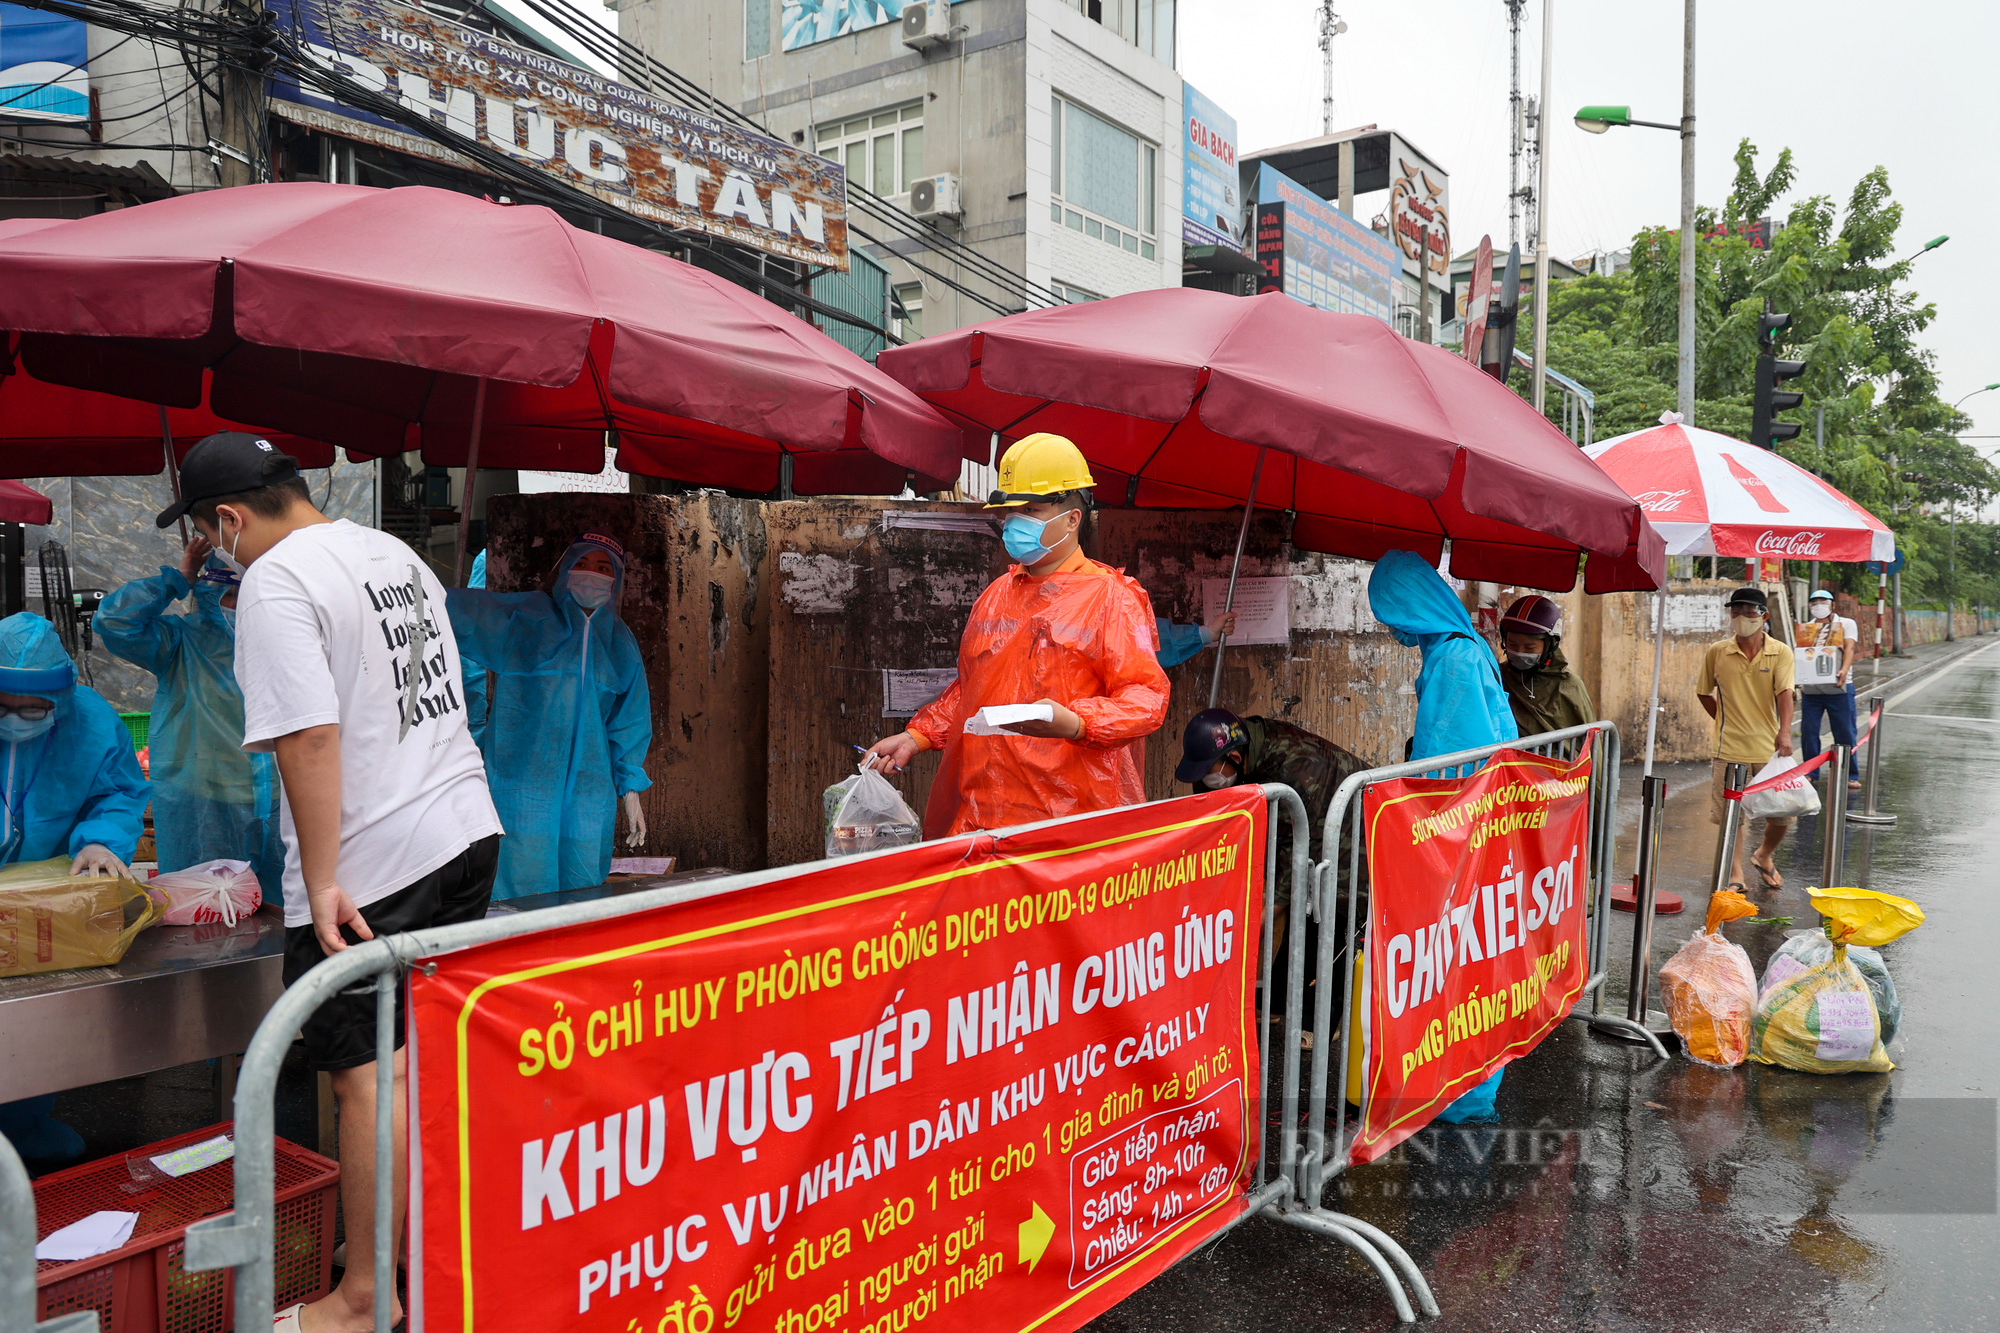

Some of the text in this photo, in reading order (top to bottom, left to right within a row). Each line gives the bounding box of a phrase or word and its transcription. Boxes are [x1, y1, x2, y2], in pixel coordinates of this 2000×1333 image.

[381, 26, 776, 176] HỢP TÁC XÃ CÔNG NGHIỆP VÀ DỊCH VỤ
[488, 42, 522, 62] BAN
[526, 53, 569, 79] NHÂN
[572, 72, 603, 91] DÂN
[607, 84, 647, 107] QUẬN
[651, 99, 687, 121] HOÀN
[691, 115, 721, 134] KIẾM
[364, 127, 372, 139] 2
[1190, 117, 1208, 151] GIA
[661, 154, 825, 244] TÂN
[1261, 213, 1279, 225] CỬA
[1277, 180, 1295, 205] CÔNG
[1258, 228, 1282, 240] HÀNG
[1258, 241, 1283, 253] JAPAN
[1755, 530, 1826, 556] Coca-Cola
[1438, 806, 1465, 834] HUY
[1538, 782, 1560, 805] DỊCH
[517, 833, 1238, 1077] SỞ CHỈ HUY PHÒNG CHỐNG DỊCH COVID-19 QUẬN HOÀN KIẾM
[1447, 984, 1508, 1048] CHỐNG
[521, 905, 1234, 1231] KHU VỰC TIẾP NHẬN CUNG ỨNG
[579, 1003, 1210, 1314] PHỤC VỤ NHÂN DÂN KHU VỰC CÁCH LY
[1082, 1107, 1221, 1188] Giờ tiếp nhận:
[1082, 1142, 1206, 1231] Sáng: 8h-10h
[657, 1045, 1233, 1333] đồ gửi đưa vào 1 túi cho 1 gia đình và ghi rõ:
[1084, 1216, 1144, 1271] Chiều:
[1151, 1191, 1183, 1228] 14h
[1198, 1163, 1228, 1194] 16h
[775, 1211, 985, 1333] thoại người gửi
[945, 1252, 1004, 1304] nhận
